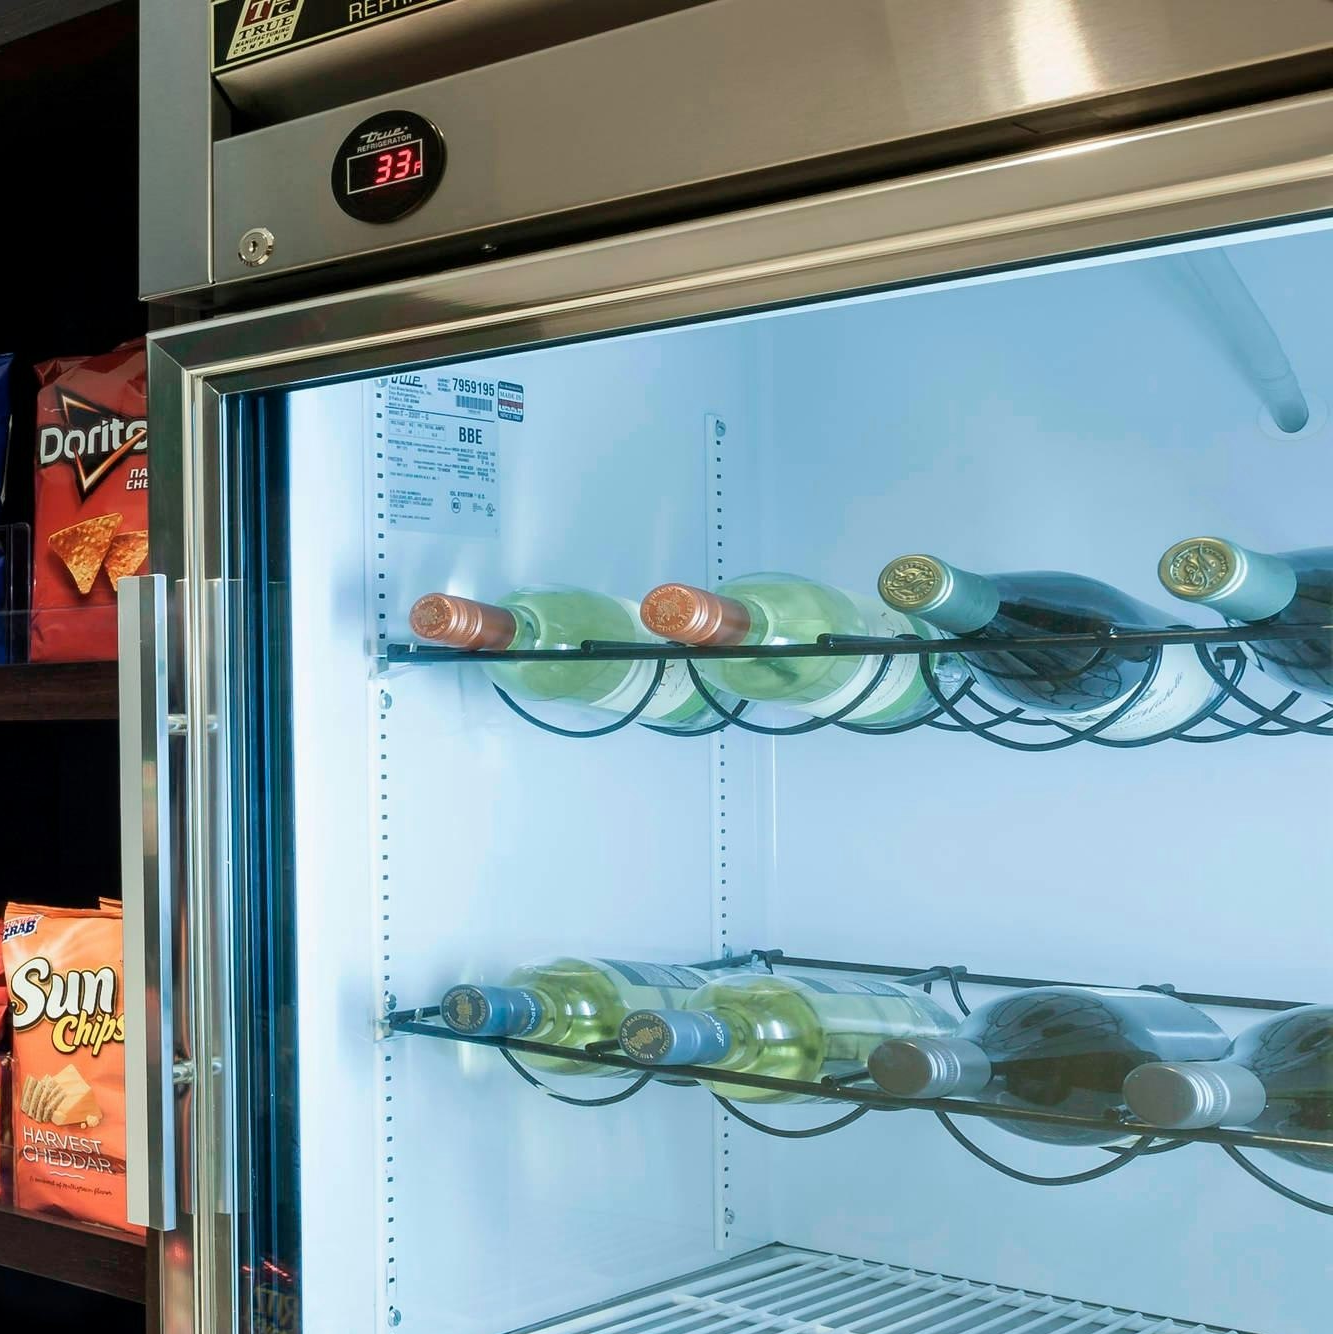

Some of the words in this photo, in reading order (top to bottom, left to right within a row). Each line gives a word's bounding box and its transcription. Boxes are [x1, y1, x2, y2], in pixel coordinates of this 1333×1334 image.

[235, 25, 291, 48] MANUFACTURING
[238, 14, 295, 39] TRUE
[232, 31, 290, 56] COMPANY
[357, 134, 412, 153] REFRIGERATOR
[452, 378, 495, 397] 7959195
[40, 420, 148, 464] Dorito
[459, 426, 482, 444] BBE
[11, 957, 115, 1028] Sun
[52, 1010, 124, 1056] Chips
[23, 1125, 102, 1154] HARVEST
[23, 1146, 113, 1174] CHEDDAR
